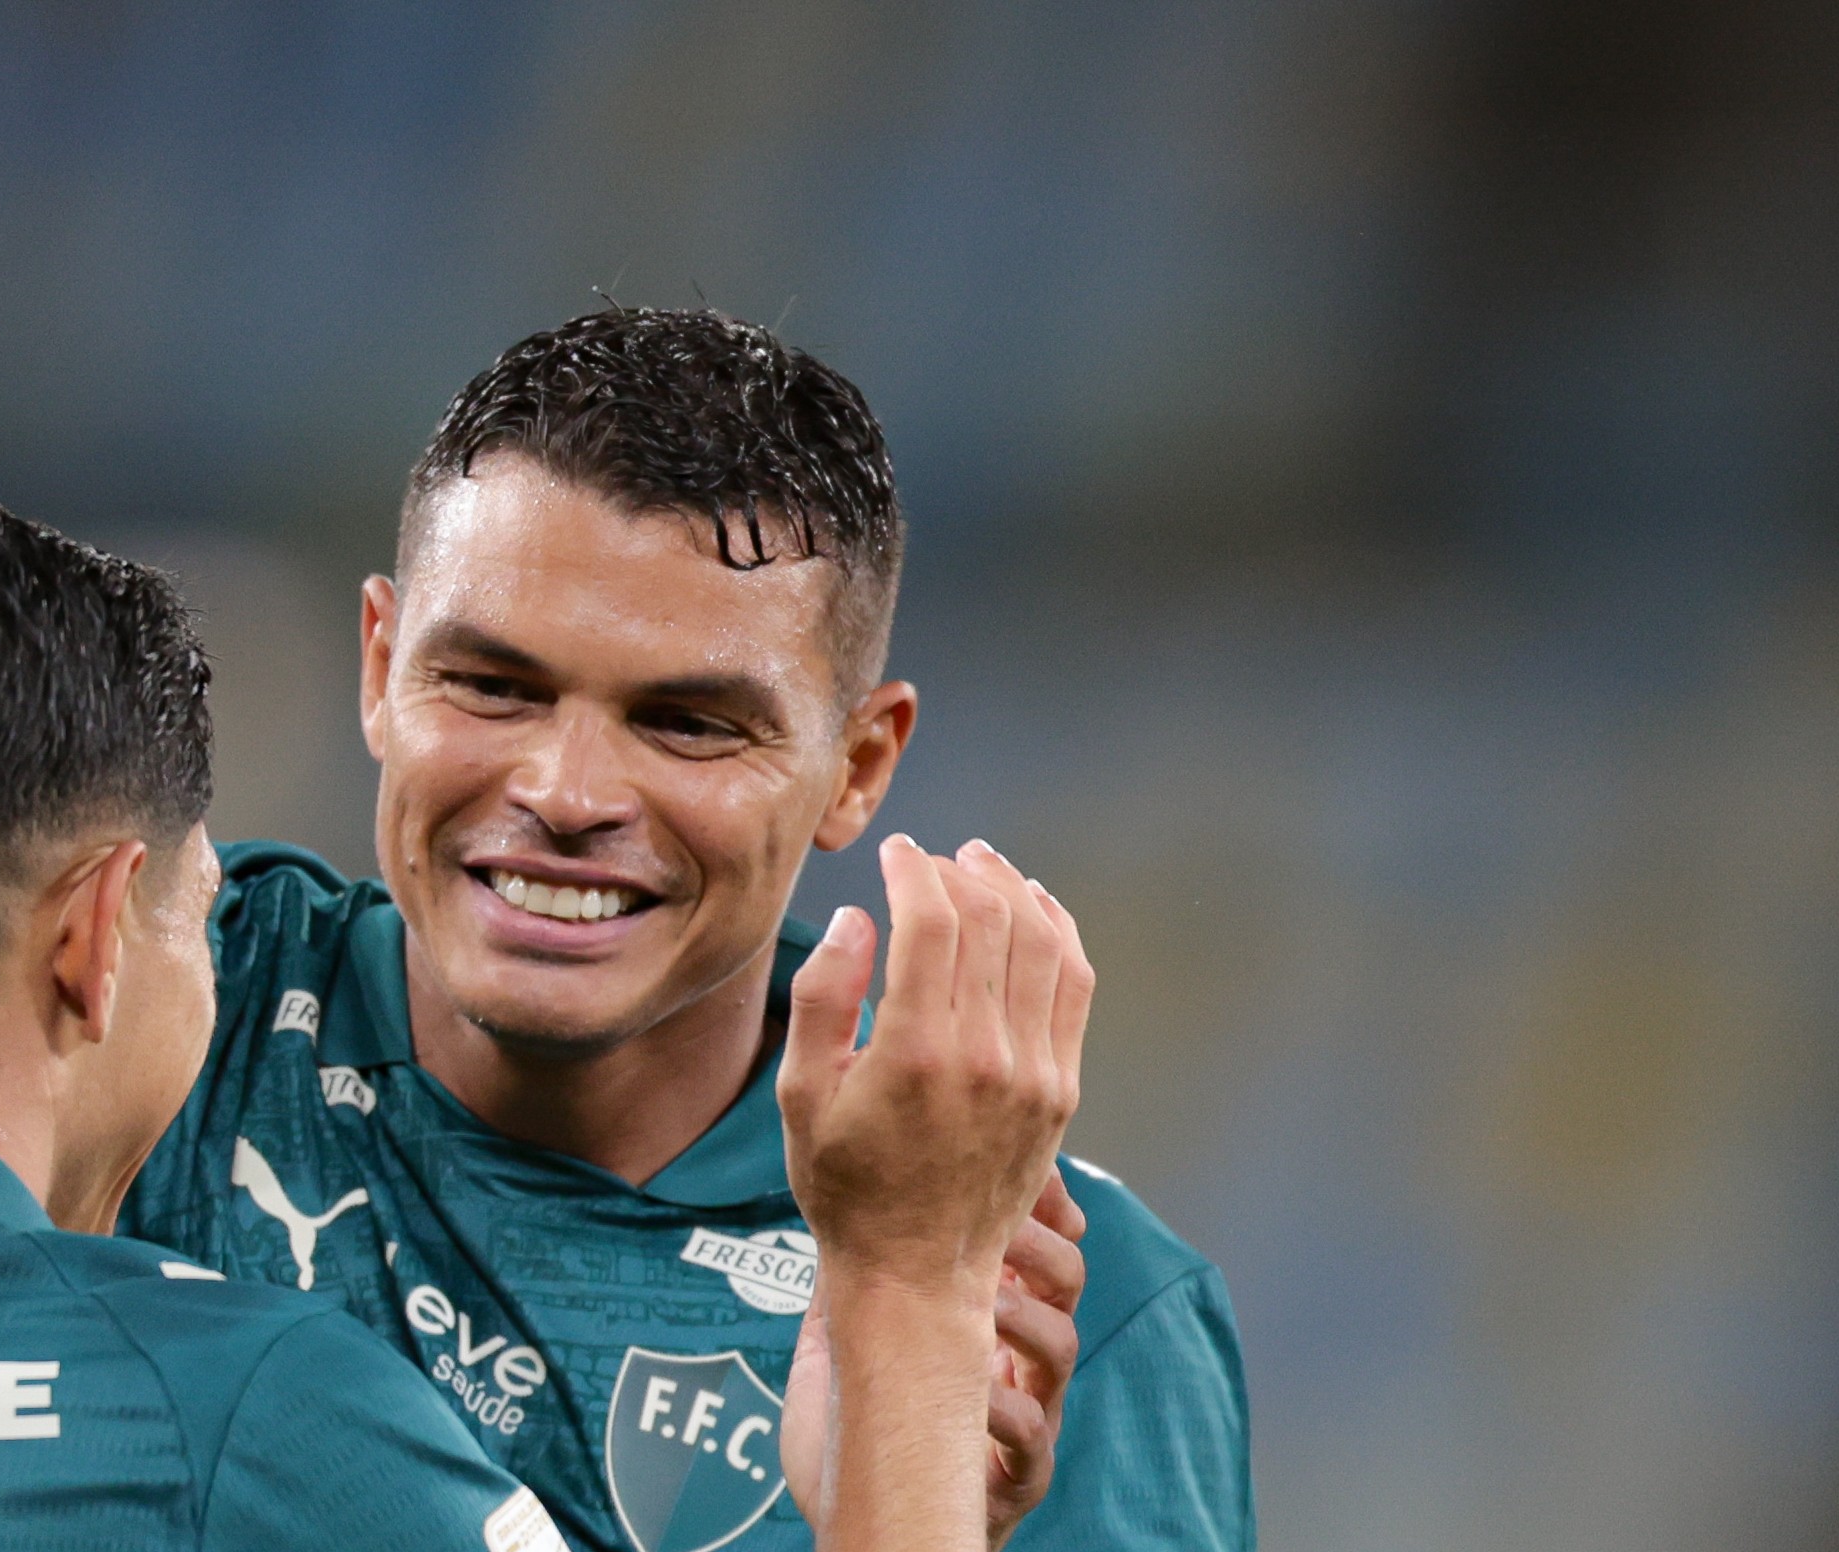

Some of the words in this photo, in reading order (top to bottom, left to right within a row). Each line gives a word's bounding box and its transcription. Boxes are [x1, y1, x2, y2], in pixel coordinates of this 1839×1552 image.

[693, 1240, 816, 1290] FRESCA
[384, 1242, 546, 1397] eve
[431, 1353, 525, 1435] saúde
[639, 1375, 773, 1482] F.F.C.
